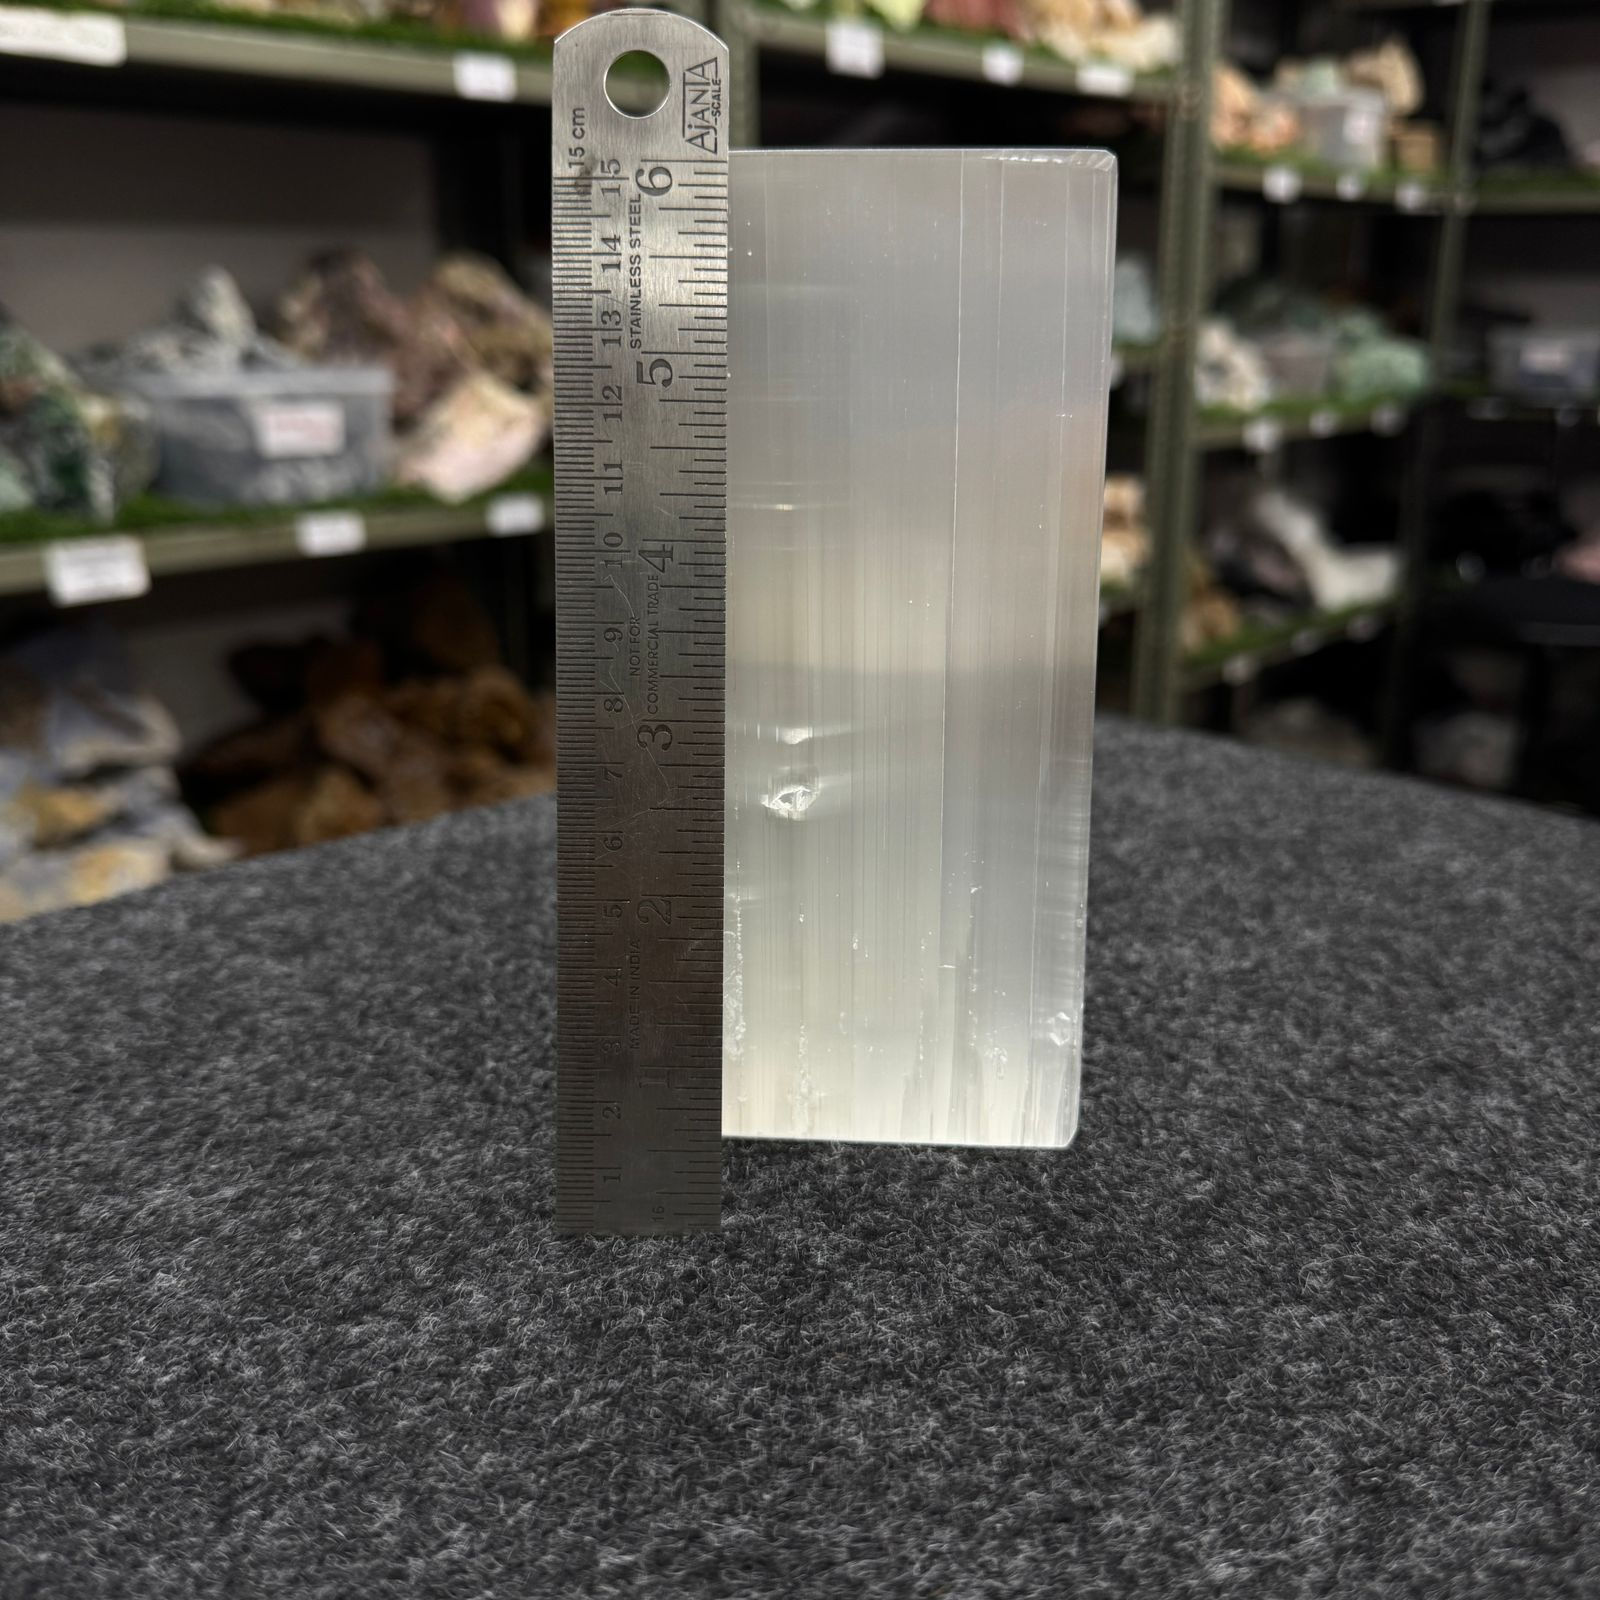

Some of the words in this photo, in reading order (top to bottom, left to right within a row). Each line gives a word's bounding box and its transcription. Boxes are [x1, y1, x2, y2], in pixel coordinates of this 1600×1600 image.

[572, 107, 585, 139] cm
[569, 146, 585, 168] 15
[601, 159, 621, 197] 15
[635, 166, 673, 197] 6
[629, 193, 641, 249] STEEL
[601, 234, 621, 273] 14
[630, 255, 642, 350] STAINLESS
[601, 310, 622, 348] 13
[636, 358, 673, 388] 5
[602, 384, 623, 423] 12
[603, 459, 623, 496] 11
[603, 532, 623, 569] 10
[638, 543, 674, 574] 4
[647, 574, 659, 616] TRADE
[603, 627, 623, 643] 9
[629, 616, 641, 644] FOR
[629, 650, 641, 677] NOT
[647, 621, 659, 715] COMMERCIAL
[603, 697, 623, 713] 8
[636, 723, 673, 751] 3
[603, 767, 623, 783] 7
[603, 836, 623, 851] 6
[602, 904, 623, 918] 5
[636, 899, 672, 926] 2
[629, 938, 641, 980] INDIA
[601, 969, 622, 987] 4
[629, 985, 641, 1000] IN
[629, 1003, 641, 1050] MADE
[601, 1039, 622, 1055] 3
[638, 1070, 671, 1089] 1
[602, 1105, 622, 1120] 2
[602, 1174, 622, 1184] 1
[651, 1205, 665, 1223] 16
